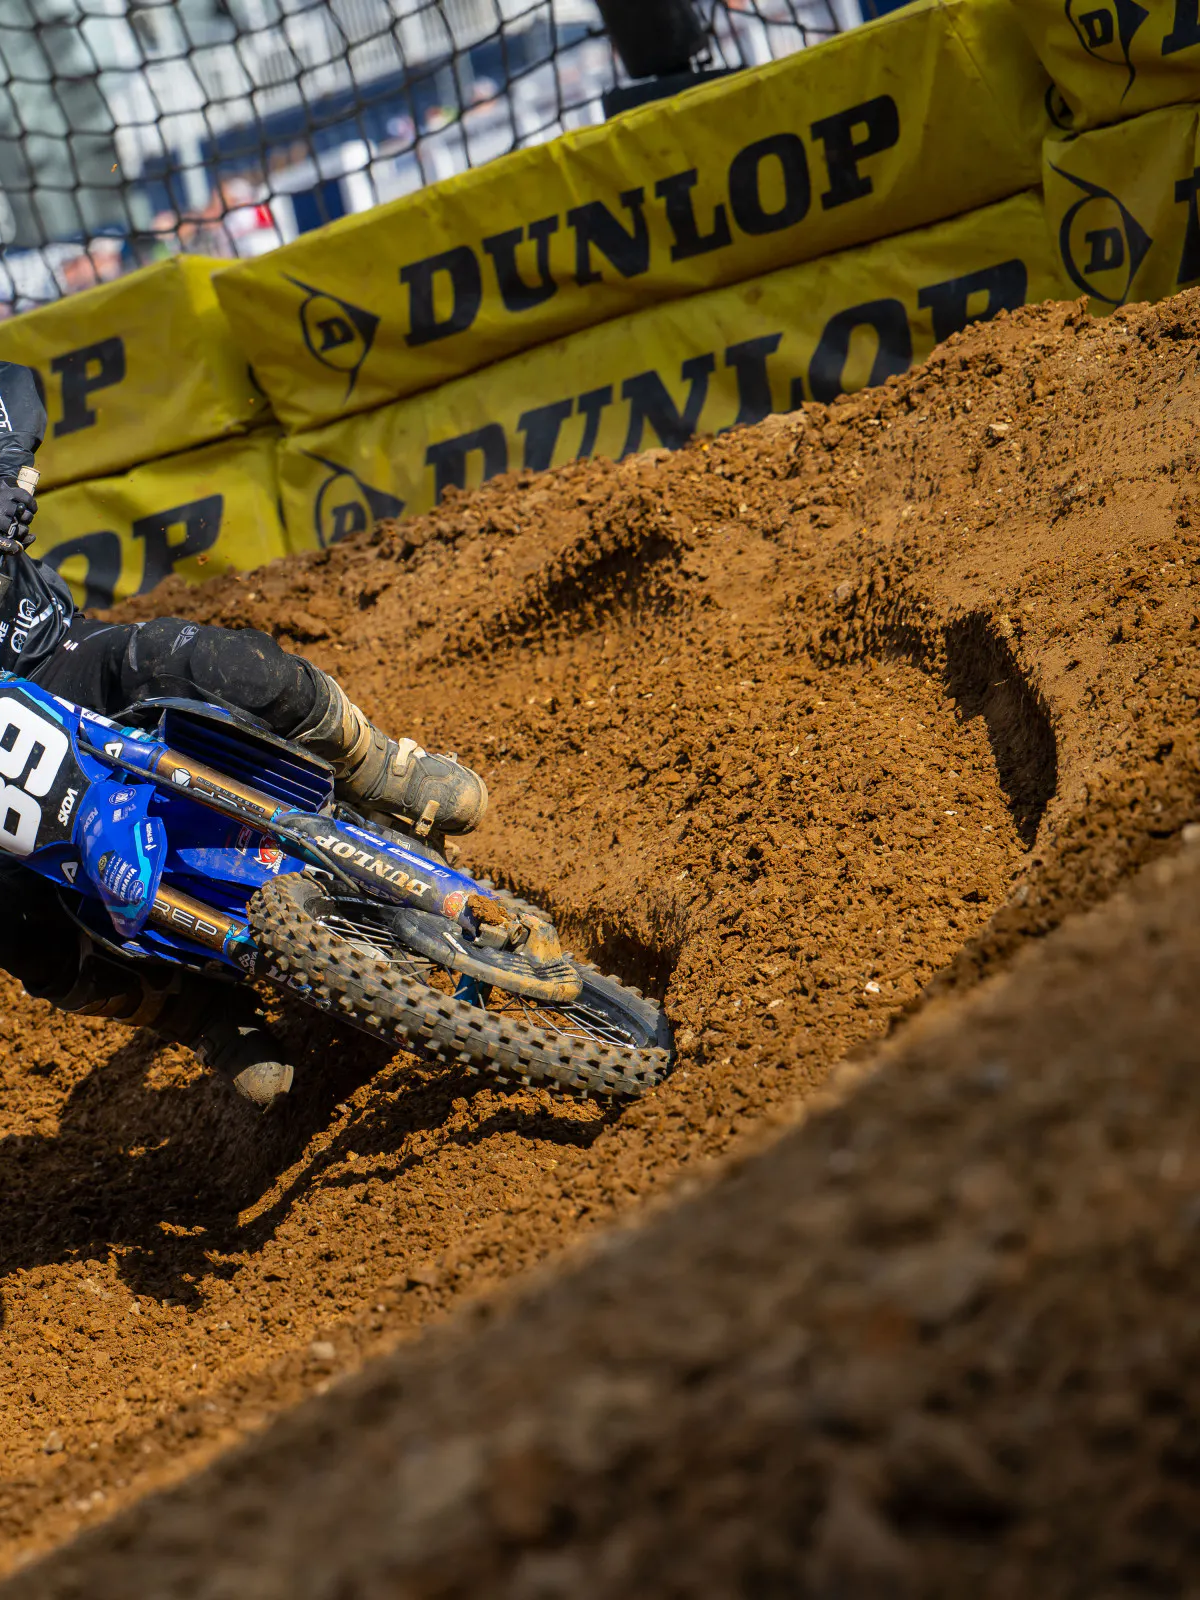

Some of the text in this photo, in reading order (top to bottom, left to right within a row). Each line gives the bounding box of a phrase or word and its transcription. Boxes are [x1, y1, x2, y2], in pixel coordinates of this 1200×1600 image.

[401, 94, 899, 347] DUNLOP
[57, 787, 79, 828] SKDA
[313, 834, 432, 899] DUNLOP
[154, 901, 219, 937] REP
